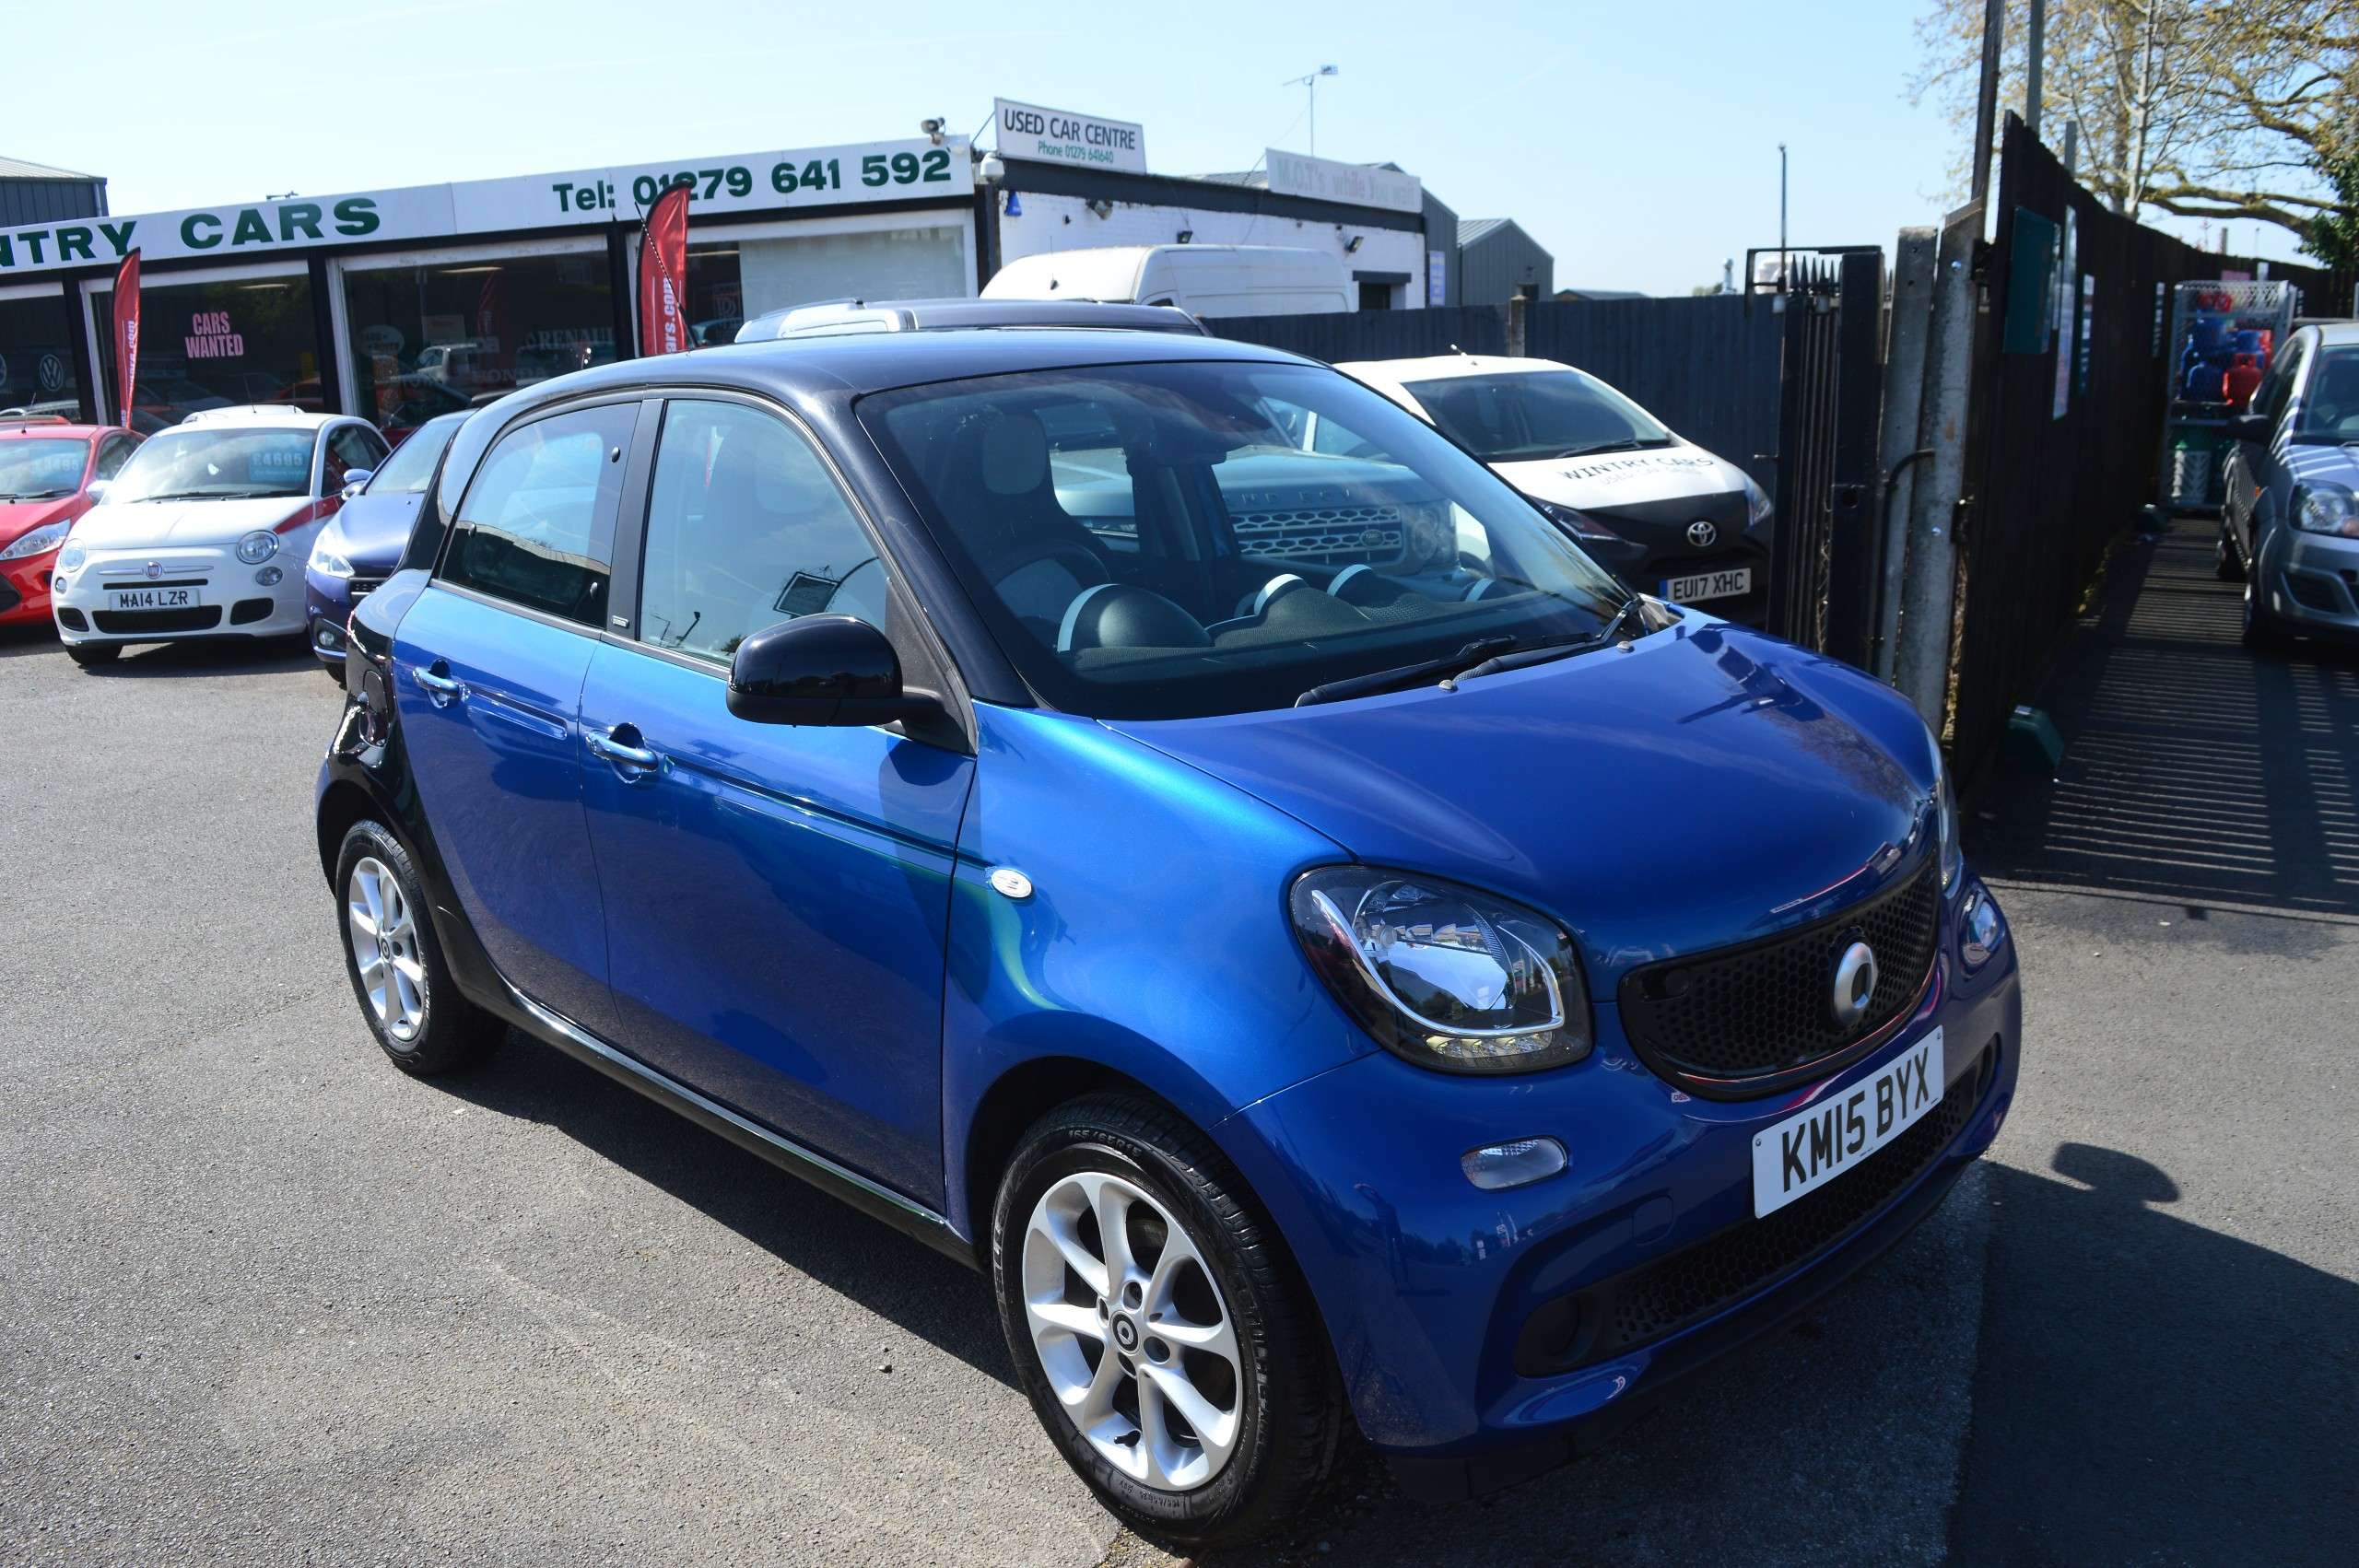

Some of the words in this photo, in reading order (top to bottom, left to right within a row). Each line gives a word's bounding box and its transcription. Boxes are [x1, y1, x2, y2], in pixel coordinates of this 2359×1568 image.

[1004, 108, 1044, 135] USED
[1050, 117, 1080, 142] CAR
[1086, 124, 1134, 149] CENTRE
[1038, 139, 1062, 157] Phone
[1064, 144, 1086, 160] 01279
[553, 178, 616, 212] Tel:
[771, 158, 840, 193] 641
[862, 149, 951, 186] 592
[181, 197, 381, 249] CARS
[193, 311, 230, 335] CARS
[185, 333, 244, 358] WANTED
[1556, 459, 1650, 480] WINTRY
[1656, 457, 1715, 467] CARS
[1673, 577, 1708, 600] EU17
[1713, 572, 1743, 594] XHC
[120, 592, 154, 608] MA14
[158, 591, 188, 606] LZR
[1782, 1091, 1865, 1193] KM15
[1876, 1047, 1929, 1139] BYX
